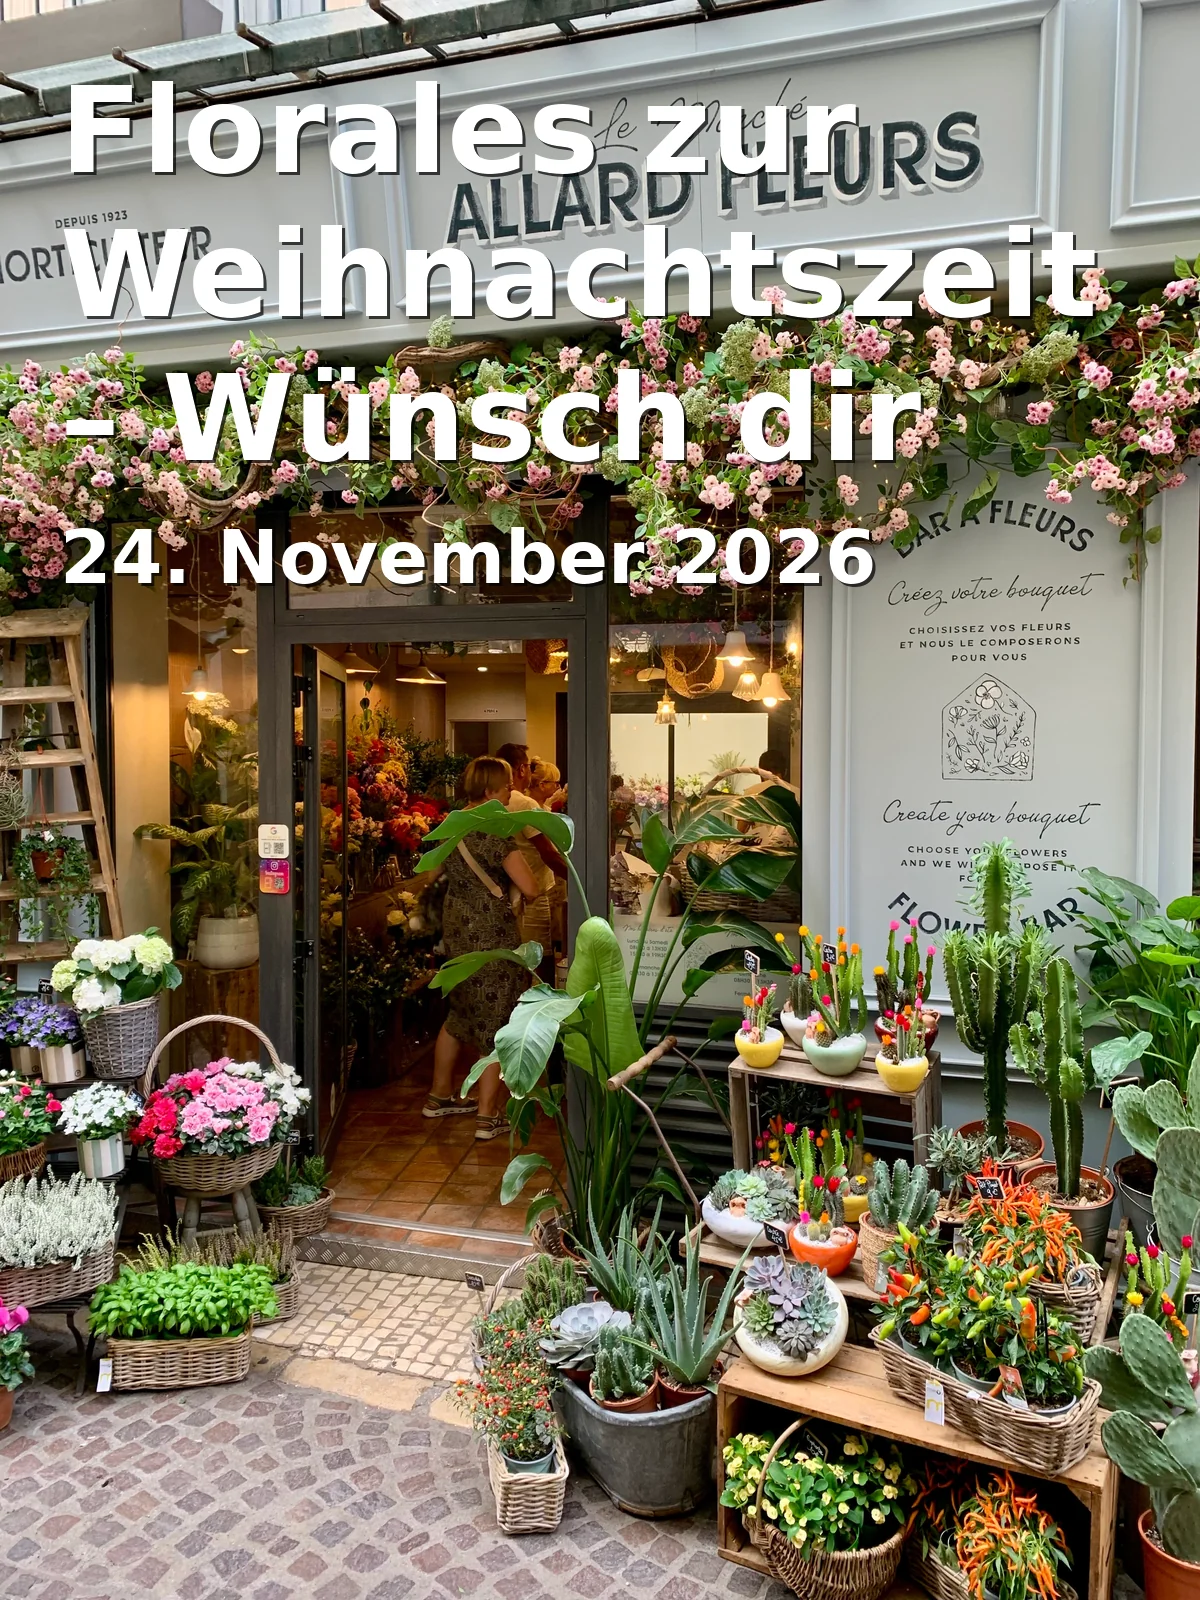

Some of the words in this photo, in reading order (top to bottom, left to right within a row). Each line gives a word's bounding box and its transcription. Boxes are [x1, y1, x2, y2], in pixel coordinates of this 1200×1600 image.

[446, 159, 694, 246] ALLARD
[55, 213, 98, 229] DEPUIS
[102, 210, 128, 222] 1923
[989, 500, 1095, 552] FLEURS
[888, 580, 947, 616] Créez
[951, 576, 1003, 600] votre
[1006, 572, 1105, 611] bouquet
[909, 624, 985, 635] CHOISISSEZ
[990, 623, 1017, 633] VOS
[1021, 622, 1072, 632] FLEURS
[899, 639, 914, 649] ET
[919, 639, 954, 649] NOUS
[960, 638, 974, 648] LE
[980, 636, 1081, 648] COMPOSERONS
[951, 653, 987, 662] POUR
[992, 652, 1028, 662] VOUS
[883, 799, 953, 824] Create
[946, 809, 1001, 836] your
[1005, 800, 1101, 840] bouquet
[908, 845, 960, 855] CHOOSE
[900, 859, 926, 867] AND
[932, 860, 952, 868] WE
